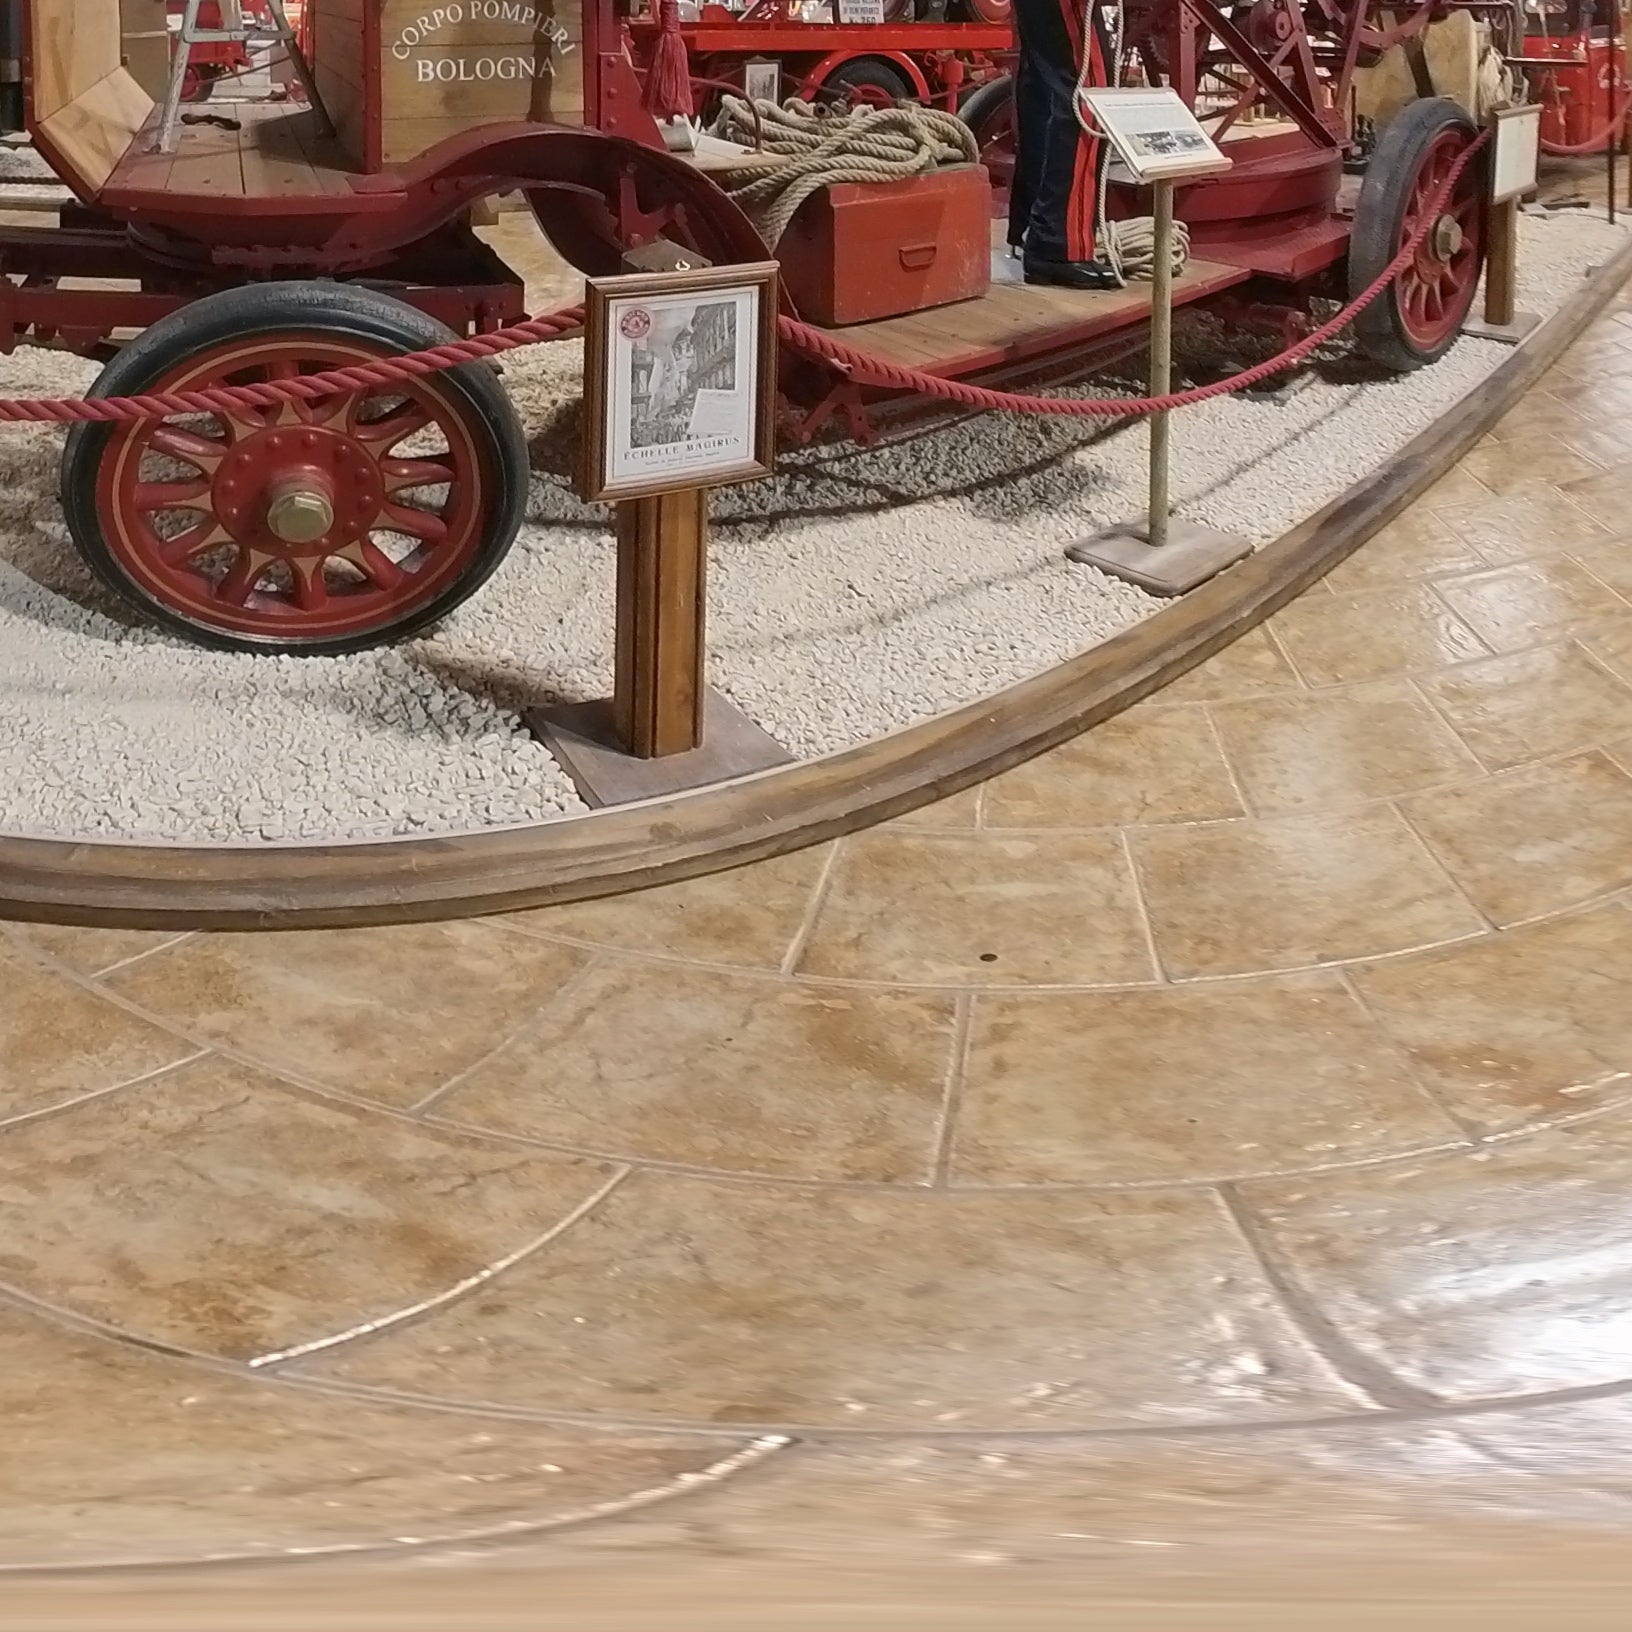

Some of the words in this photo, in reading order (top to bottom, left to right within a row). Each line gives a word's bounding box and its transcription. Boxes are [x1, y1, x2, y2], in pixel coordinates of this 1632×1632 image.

[391, 3, 464, 61] CORPO
[469, 0, 576, 56] POMPIERI
[416, 56, 557, 83] BOLOGNA
